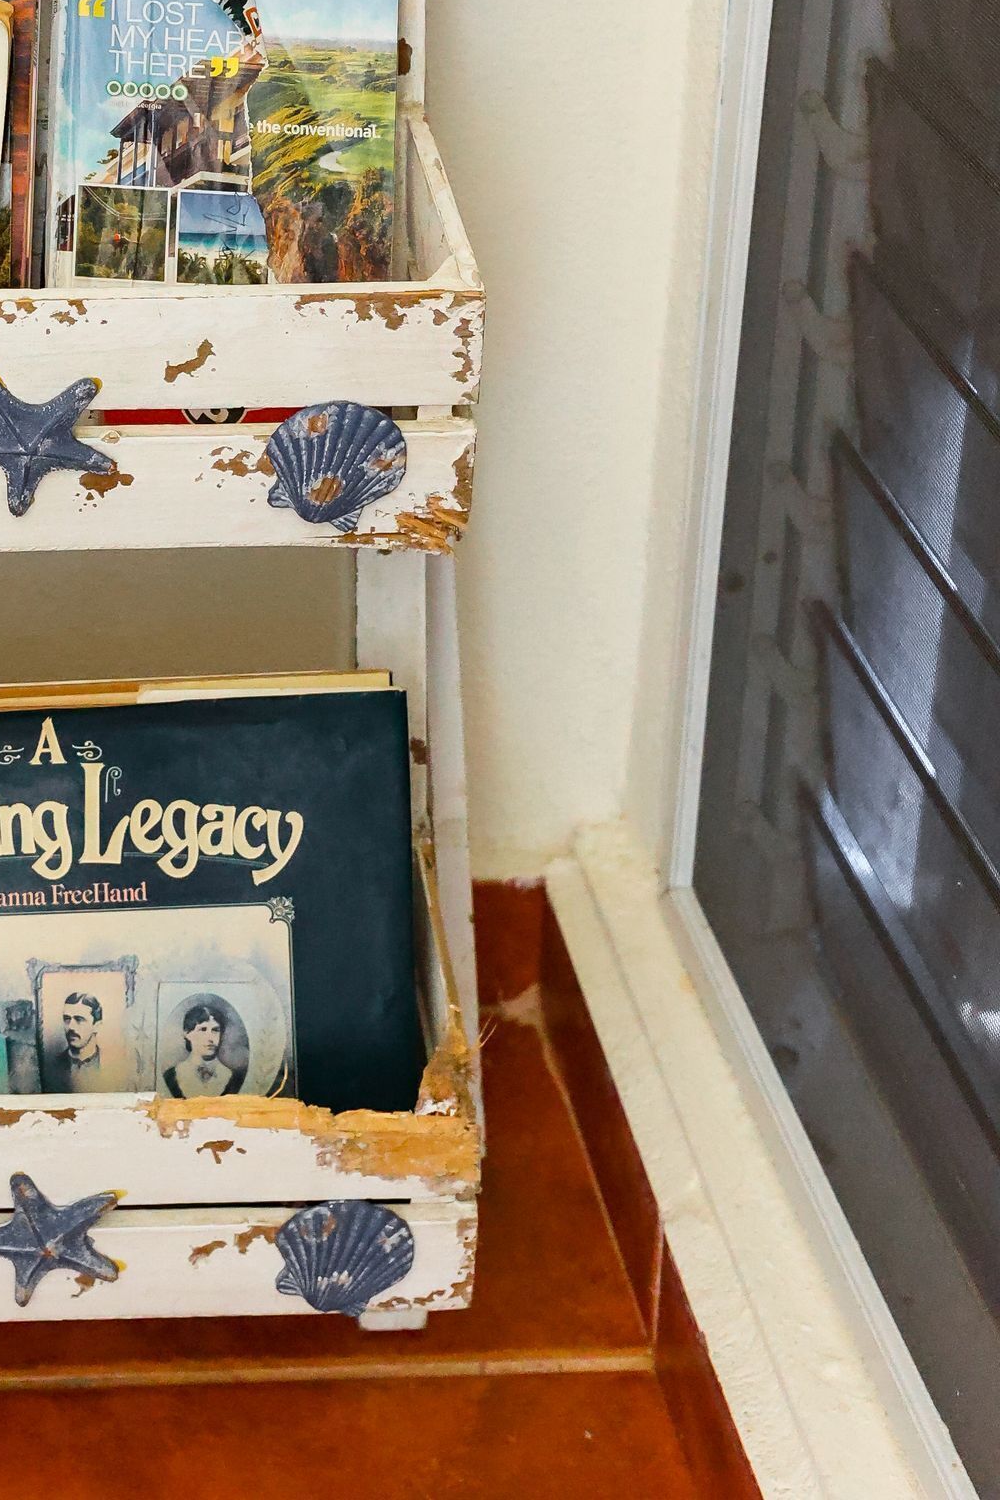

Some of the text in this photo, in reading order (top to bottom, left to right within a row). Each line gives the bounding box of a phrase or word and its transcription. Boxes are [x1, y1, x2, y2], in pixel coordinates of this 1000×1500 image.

[125, 0, 204, 26] LOST
[110, 23, 155, 49] MY
[256, 119, 281, 134] the
[29, 715, 68, 766] A
[78, 761, 304, 887] Legacy
